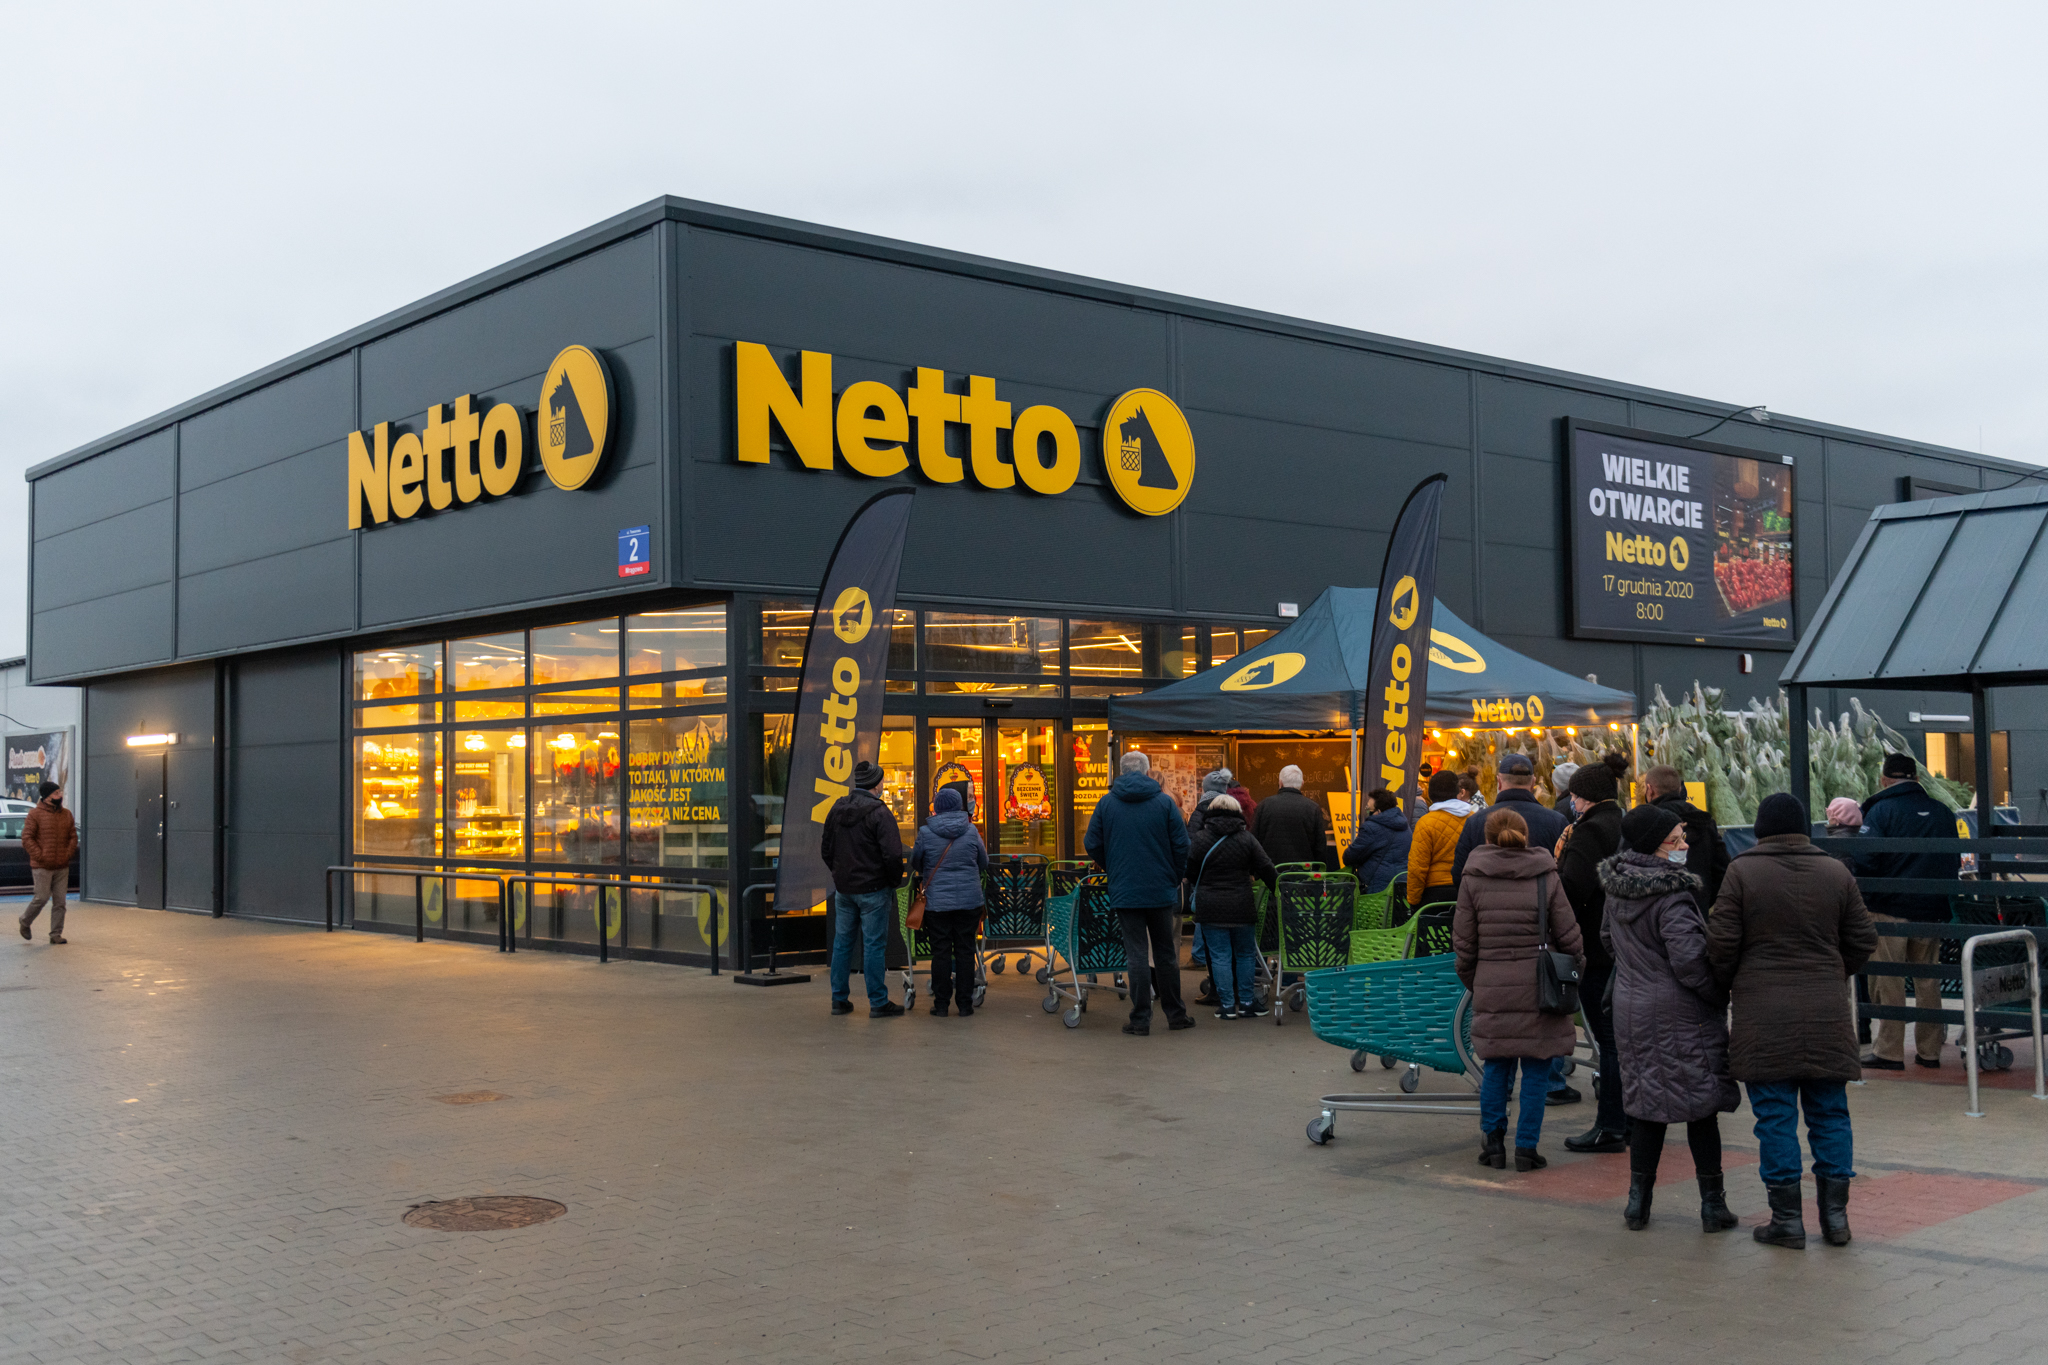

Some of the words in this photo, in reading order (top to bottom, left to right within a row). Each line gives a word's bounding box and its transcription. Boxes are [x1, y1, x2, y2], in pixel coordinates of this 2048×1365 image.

[736, 340, 1081, 495] Netto
[348, 393, 523, 530] Netto
[1601, 453, 1690, 493] WIELKIE
[1589, 488, 1703, 529] OTWARCIE
[629, 537, 639, 562] 2
[1606, 530, 1667, 567] Netto
[1602, 574, 1615, 592] 17
[1617, 577, 1662, 597] grudnia
[1664, 582, 1694, 599] 2020
[1636, 602, 1664, 621] 8:00
[1472, 698, 1525, 723] Netto
[811, 656, 860, 824] Netto
[629, 751, 661, 767] DOBRY
[663, 749, 710, 765] DYSKONT
[1085, 763, 1109, 773] WIE
[629, 770, 642, 784] TO
[643, 769, 668, 785] TAKI,
[670, 769, 680, 783] W
[682, 764, 725, 783] KTÓRYM
[1078, 776, 1109, 787] OTW
[629, 784, 666, 803] JAKOŚĆ
[668, 788, 692, 802] JEST
[1020, 790, 1039, 798] ŚWIĘTA
[629, 803, 671, 821] WYŻSZA
[672, 802, 690, 821] NIŻ
[691, 806, 721, 821] CENA
[1338, 826, 1347, 834] W
[2000, 973, 2026, 993] Netto
